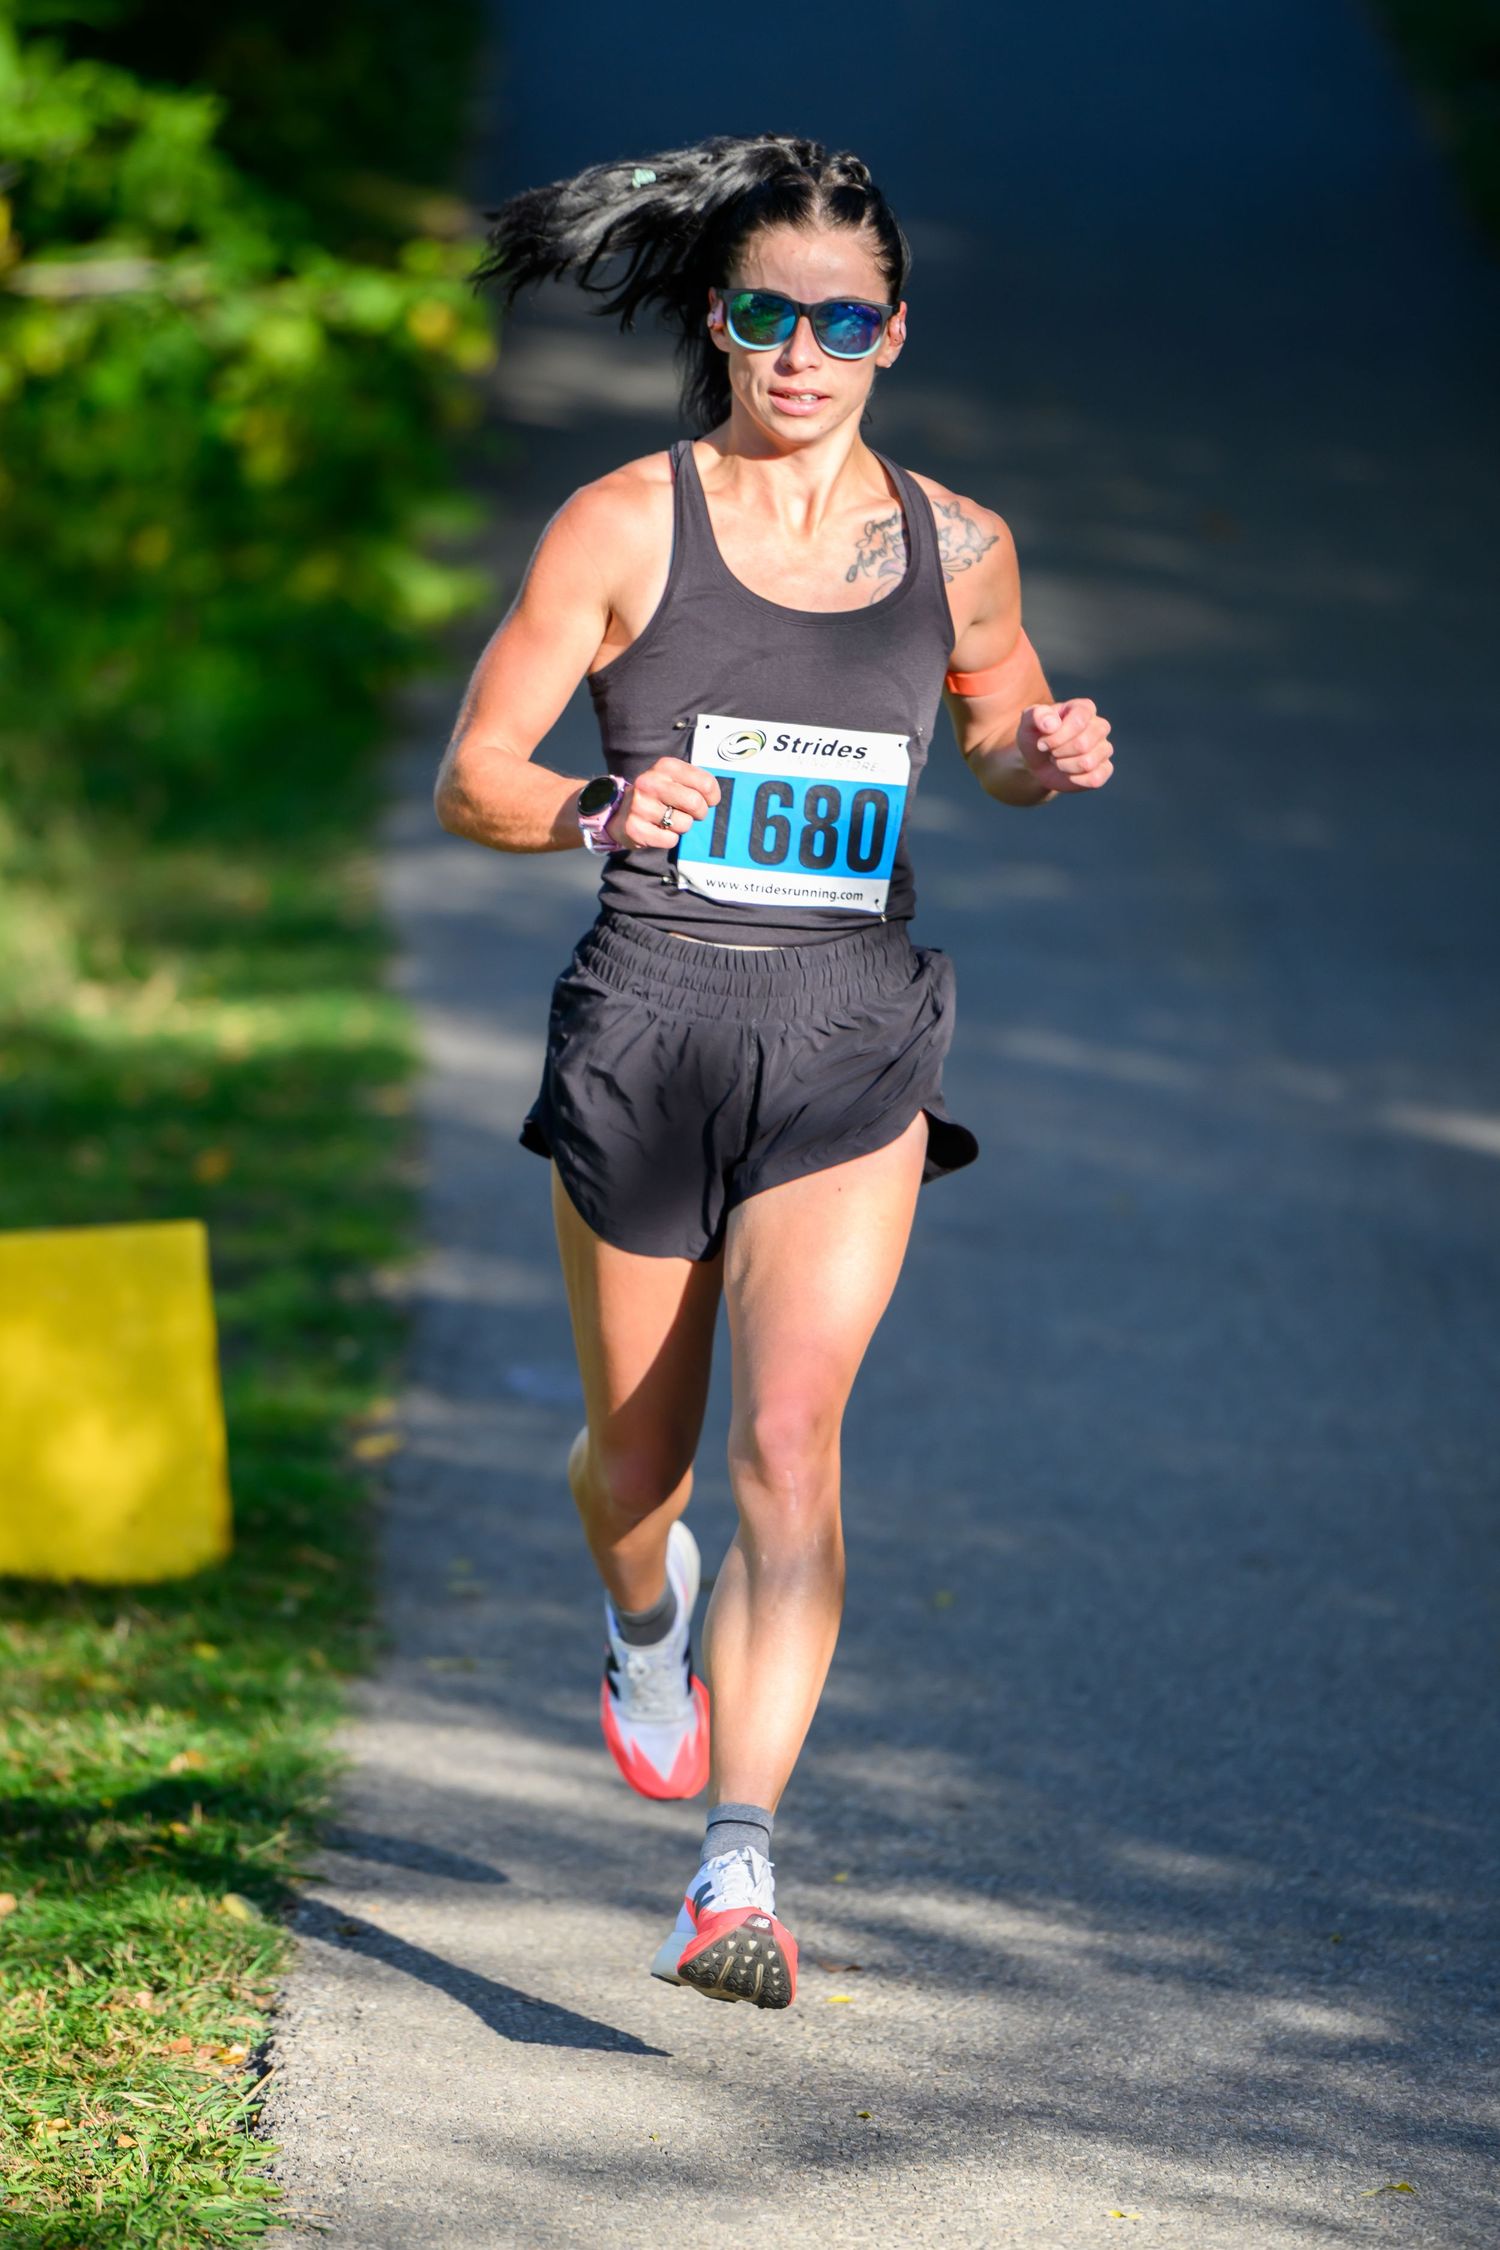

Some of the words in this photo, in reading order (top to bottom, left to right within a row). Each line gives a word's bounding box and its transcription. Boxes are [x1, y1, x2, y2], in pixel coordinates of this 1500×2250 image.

[773, 734, 868, 759] Strides
[708, 775, 890, 873] 1680
[706, 878, 863, 902] www.stridesrunning.com
